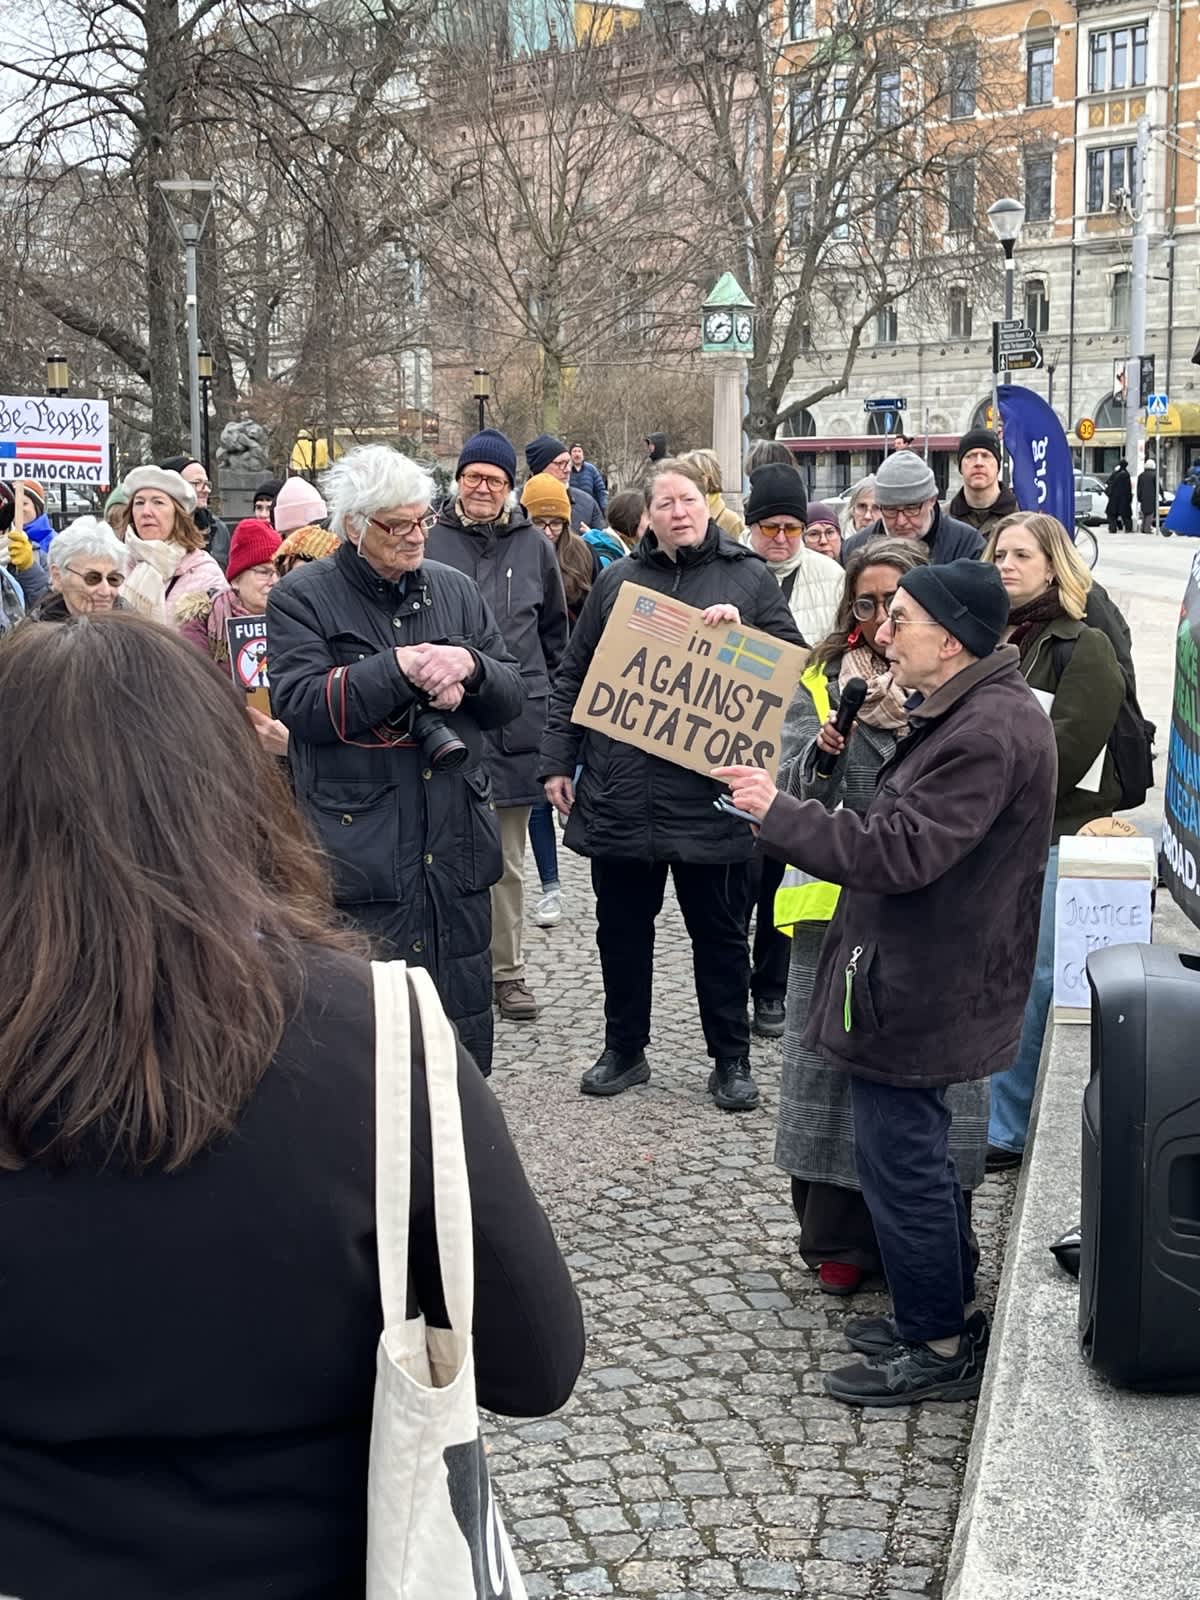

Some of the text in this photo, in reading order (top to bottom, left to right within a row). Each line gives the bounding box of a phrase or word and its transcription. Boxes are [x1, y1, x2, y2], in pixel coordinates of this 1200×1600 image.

[23, 399, 103, 440] People
[13, 463, 103, 481] DEMOCRACY
[687, 630, 712, 656] in
[621, 647, 783, 731] AGAINST
[587, 682, 775, 769] DICTATORS
[1066, 897, 1143, 926] JUSTICE
